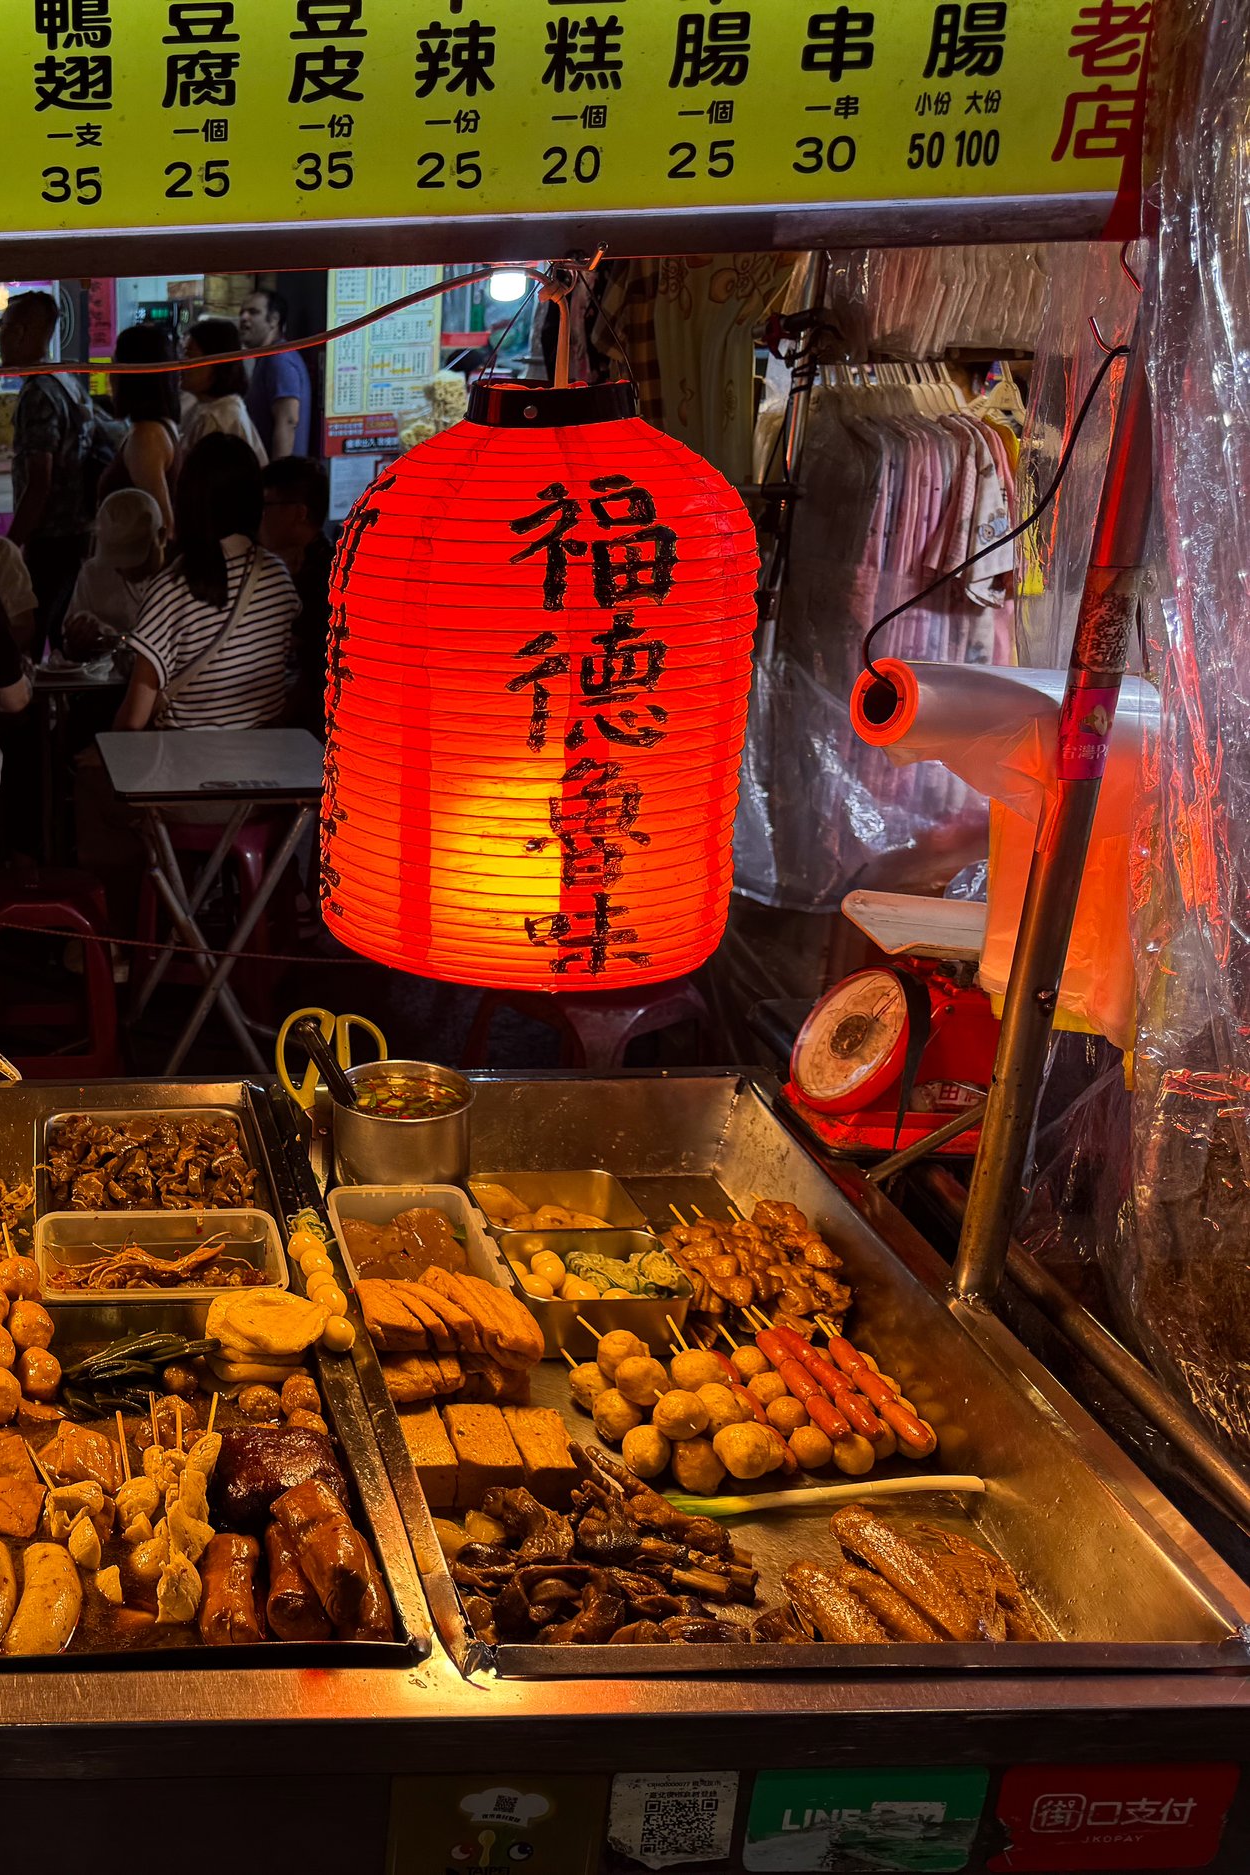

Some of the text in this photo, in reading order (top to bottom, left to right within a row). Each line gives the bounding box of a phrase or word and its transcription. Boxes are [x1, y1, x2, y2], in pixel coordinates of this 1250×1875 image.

[34, 0, 113, 112] 鴨翅
[161, 1, 241, 108] 豆腐
[287, 0, 368, 103] 豆皮
[414, 0, 497, 98] 辣
[541, 0, 625, 92] 糕
[668, 0, 751, 88] 腸
[801, 5, 875, 82] 串
[922, 2, 1008, 78] 腸
[1051, 0, 1152, 162] 老店
[425, 109, 481, 133] 一份
[551, 105, 607, 129] 一個
[677, 100, 734, 124] 一個
[805, 95, 860, 119] 一串
[915, 90, 1002, 116] 小份 大份
[47, 122, 103, 147] 一支
[173, 118, 228, 142] 一個
[299, 114, 355, 138] 一份
[541, 145, 601, 184] 20
[667, 139, 735, 179] 25
[792, 135, 856, 173] 30
[907, 130, 1000, 169] 50 100
[41, 166, 102, 206] 35
[164, 160, 230, 198] 25
[295, 151, 354, 191] 35
[416, 150, 482, 189] 25
[1029, 1793, 1198, 1833] 街口支付
[1081, 1834, 1145, 1844] JKOPAY
